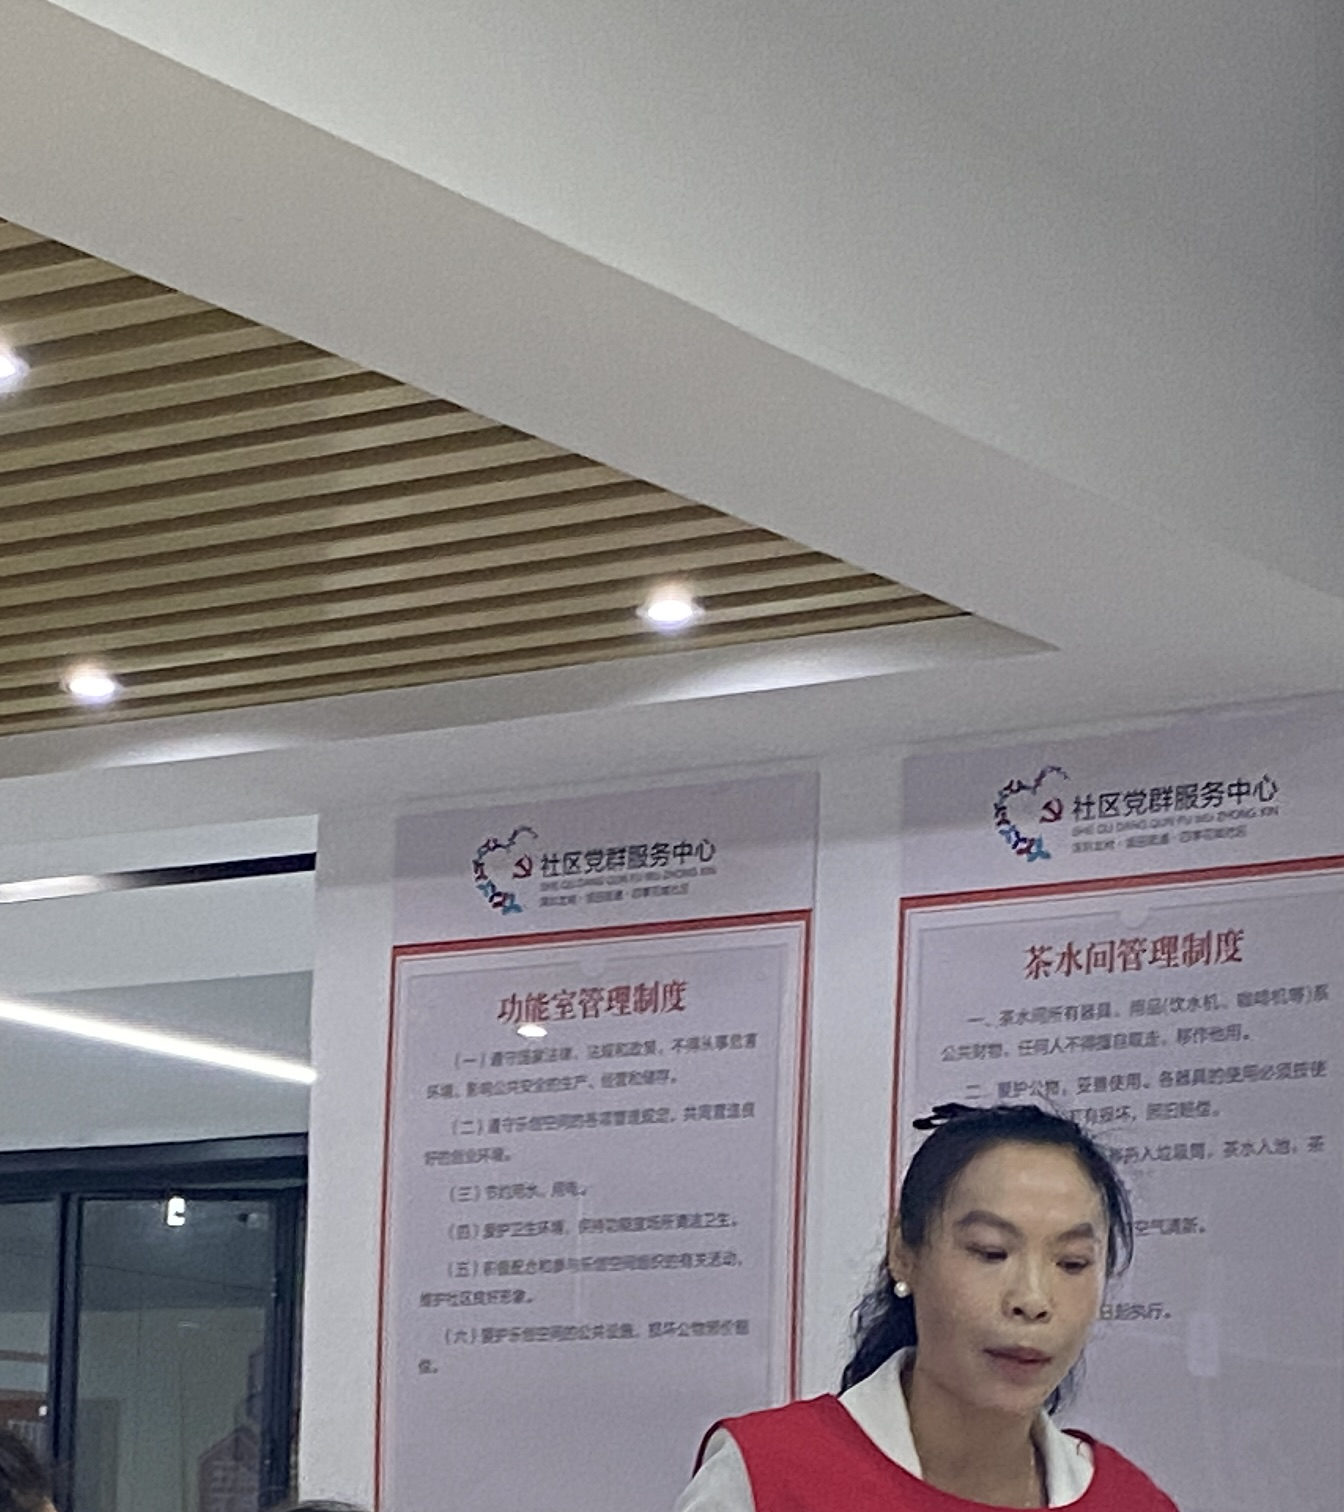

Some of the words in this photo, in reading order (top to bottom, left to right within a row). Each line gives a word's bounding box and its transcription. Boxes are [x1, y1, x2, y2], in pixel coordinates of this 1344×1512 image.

[1073, 774, 1280, 822] 社区党群服务中心
[540, 839, 716, 878] 社区党群服务中心
[1024, 929, 1244, 980] 茶水间管理制度
[498, 980, 688, 1024] 功能室管理制度
